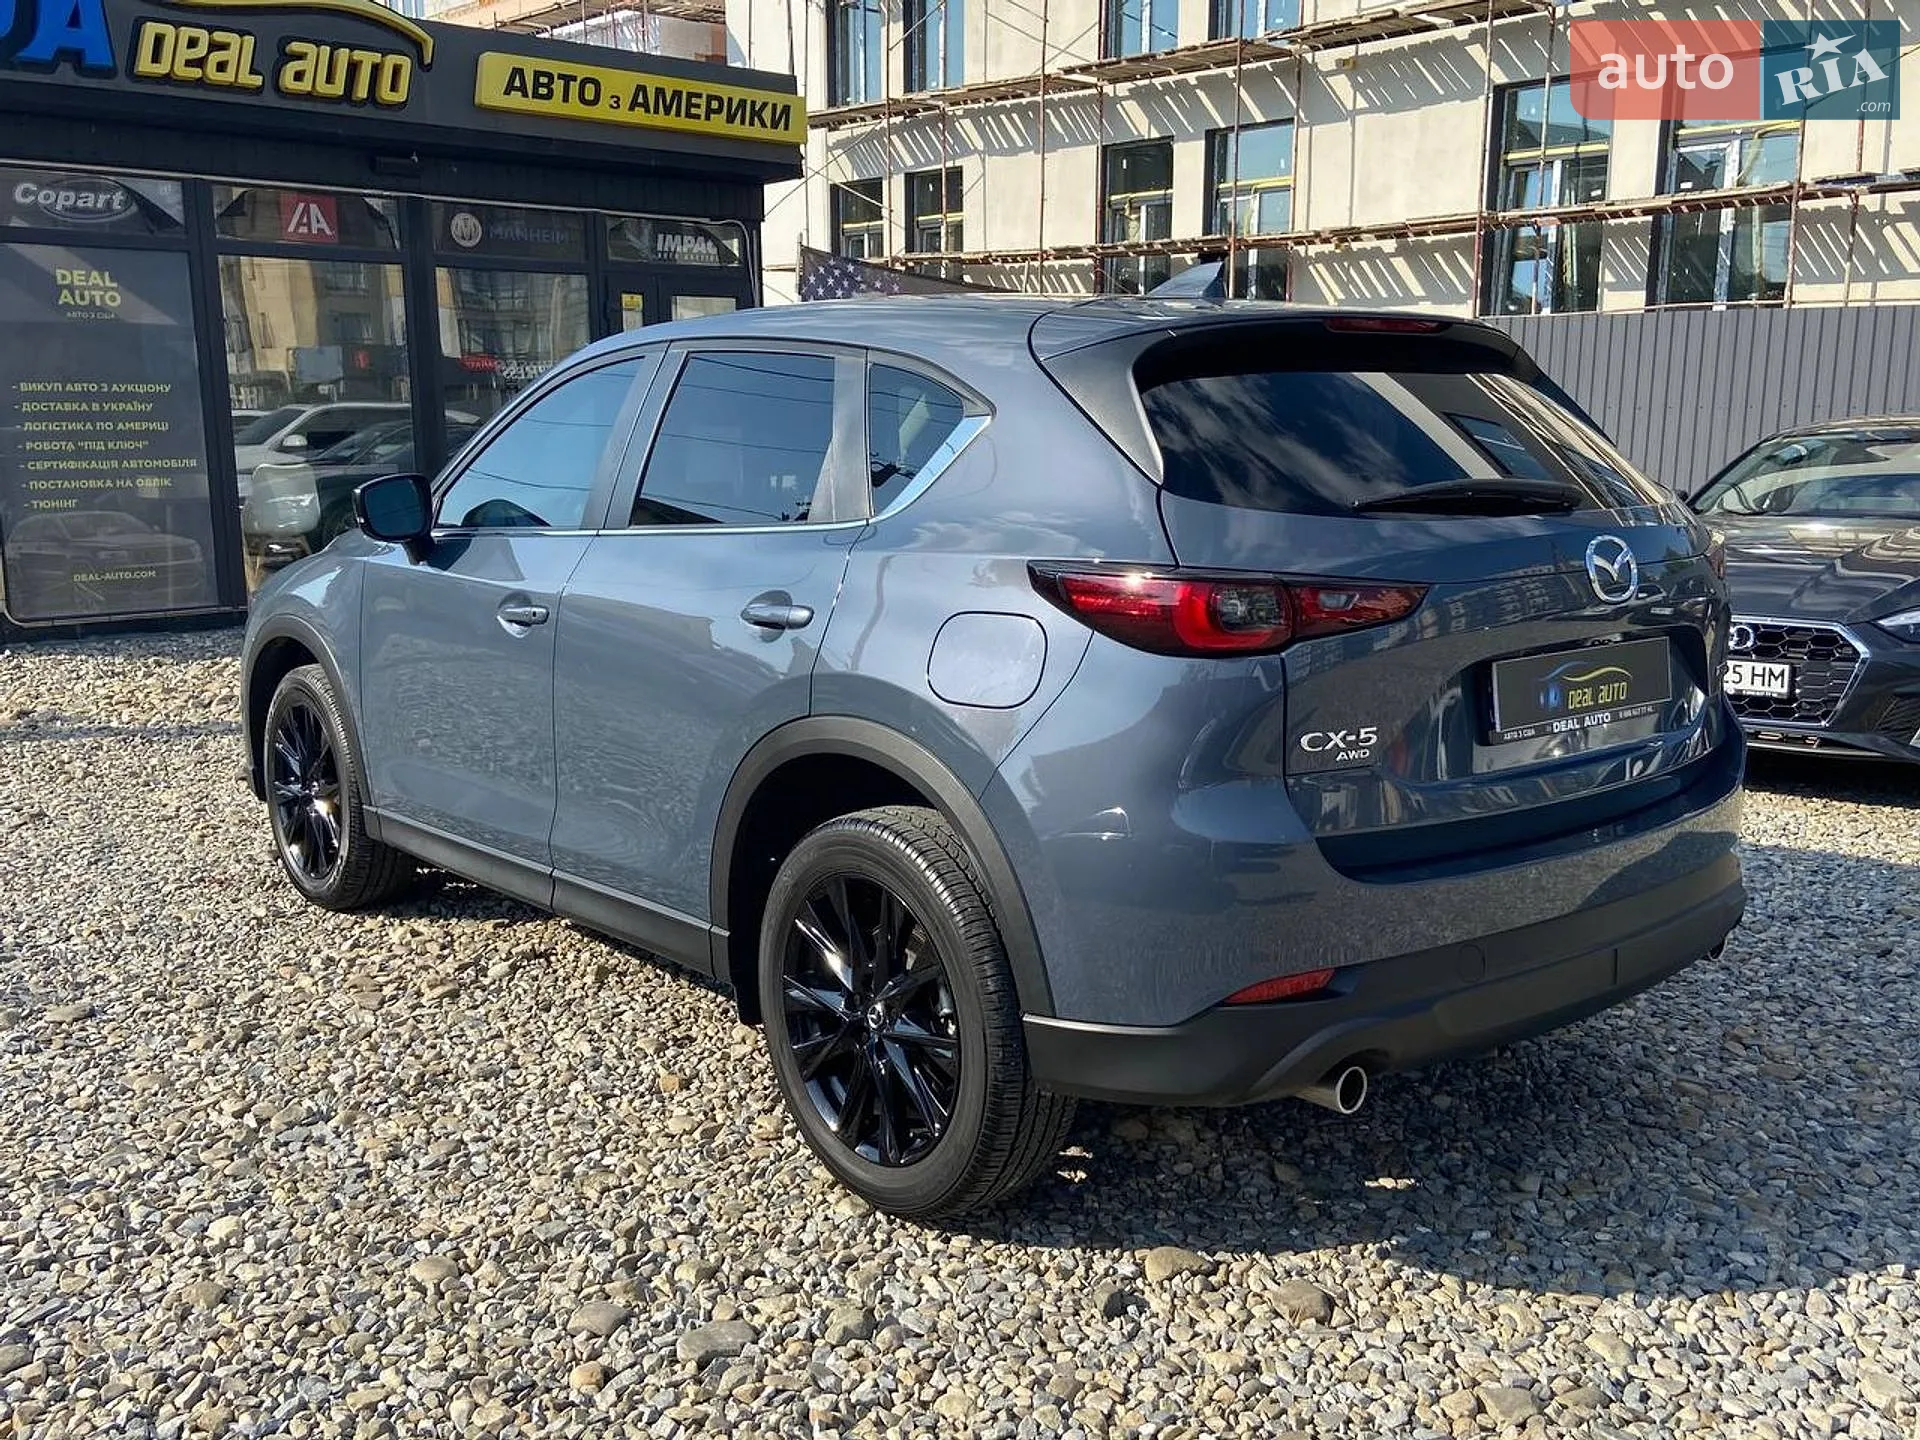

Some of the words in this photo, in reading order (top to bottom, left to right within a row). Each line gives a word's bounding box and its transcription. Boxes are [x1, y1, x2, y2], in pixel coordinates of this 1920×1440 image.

[503, 67, 601, 107] АВТО
[627, 83, 792, 132] АМЕРИКИ
[15, 183, 124, 211] Copart
[56, 269, 118, 287] DEAL
[59, 289, 121, 307] AUTO
[20, 382, 63, 393] ВИКУП
[66, 382, 98, 393] АВТО
[111, 383, 171, 394] АУКЦІОНУ
[22, 402, 90, 412] ДОСТАВКА
[24, 421, 93, 432] ЛОГІСТИКА
[26, 441, 75, 451] РОБОТА
[121, 458, 197, 469] АВТОМОБІЛЯ
[30, 479, 113, 490] ПОСТАНОВКА
[116, 478, 133, 489] НА
[1552, 719, 1581, 733] DEAL
[1584, 712, 1611, 728] AUTO
[1300, 726, 1378, 752] CX-5
[1336, 748, 1370, 761] AWD
